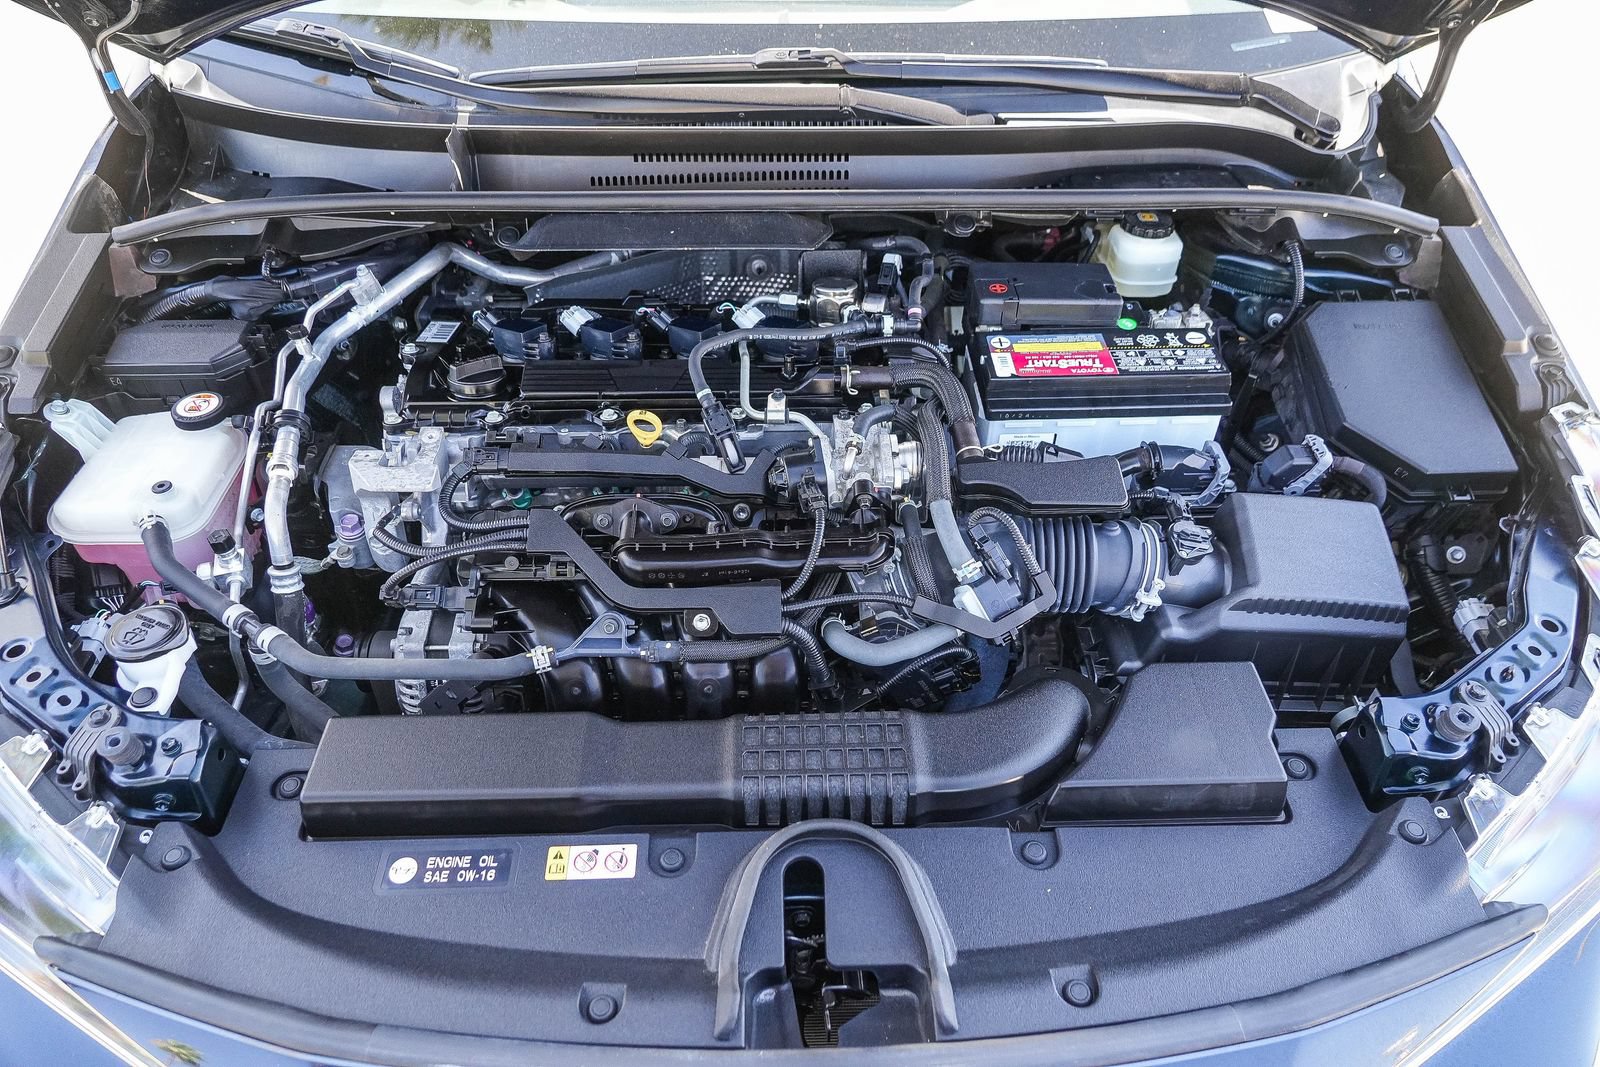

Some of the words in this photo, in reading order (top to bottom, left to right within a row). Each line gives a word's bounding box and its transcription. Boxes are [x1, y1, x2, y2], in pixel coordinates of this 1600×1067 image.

[426, 855, 472, 869] ENGINE
[479, 855, 498, 868] OIL
[423, 870, 450, 883] SAE
